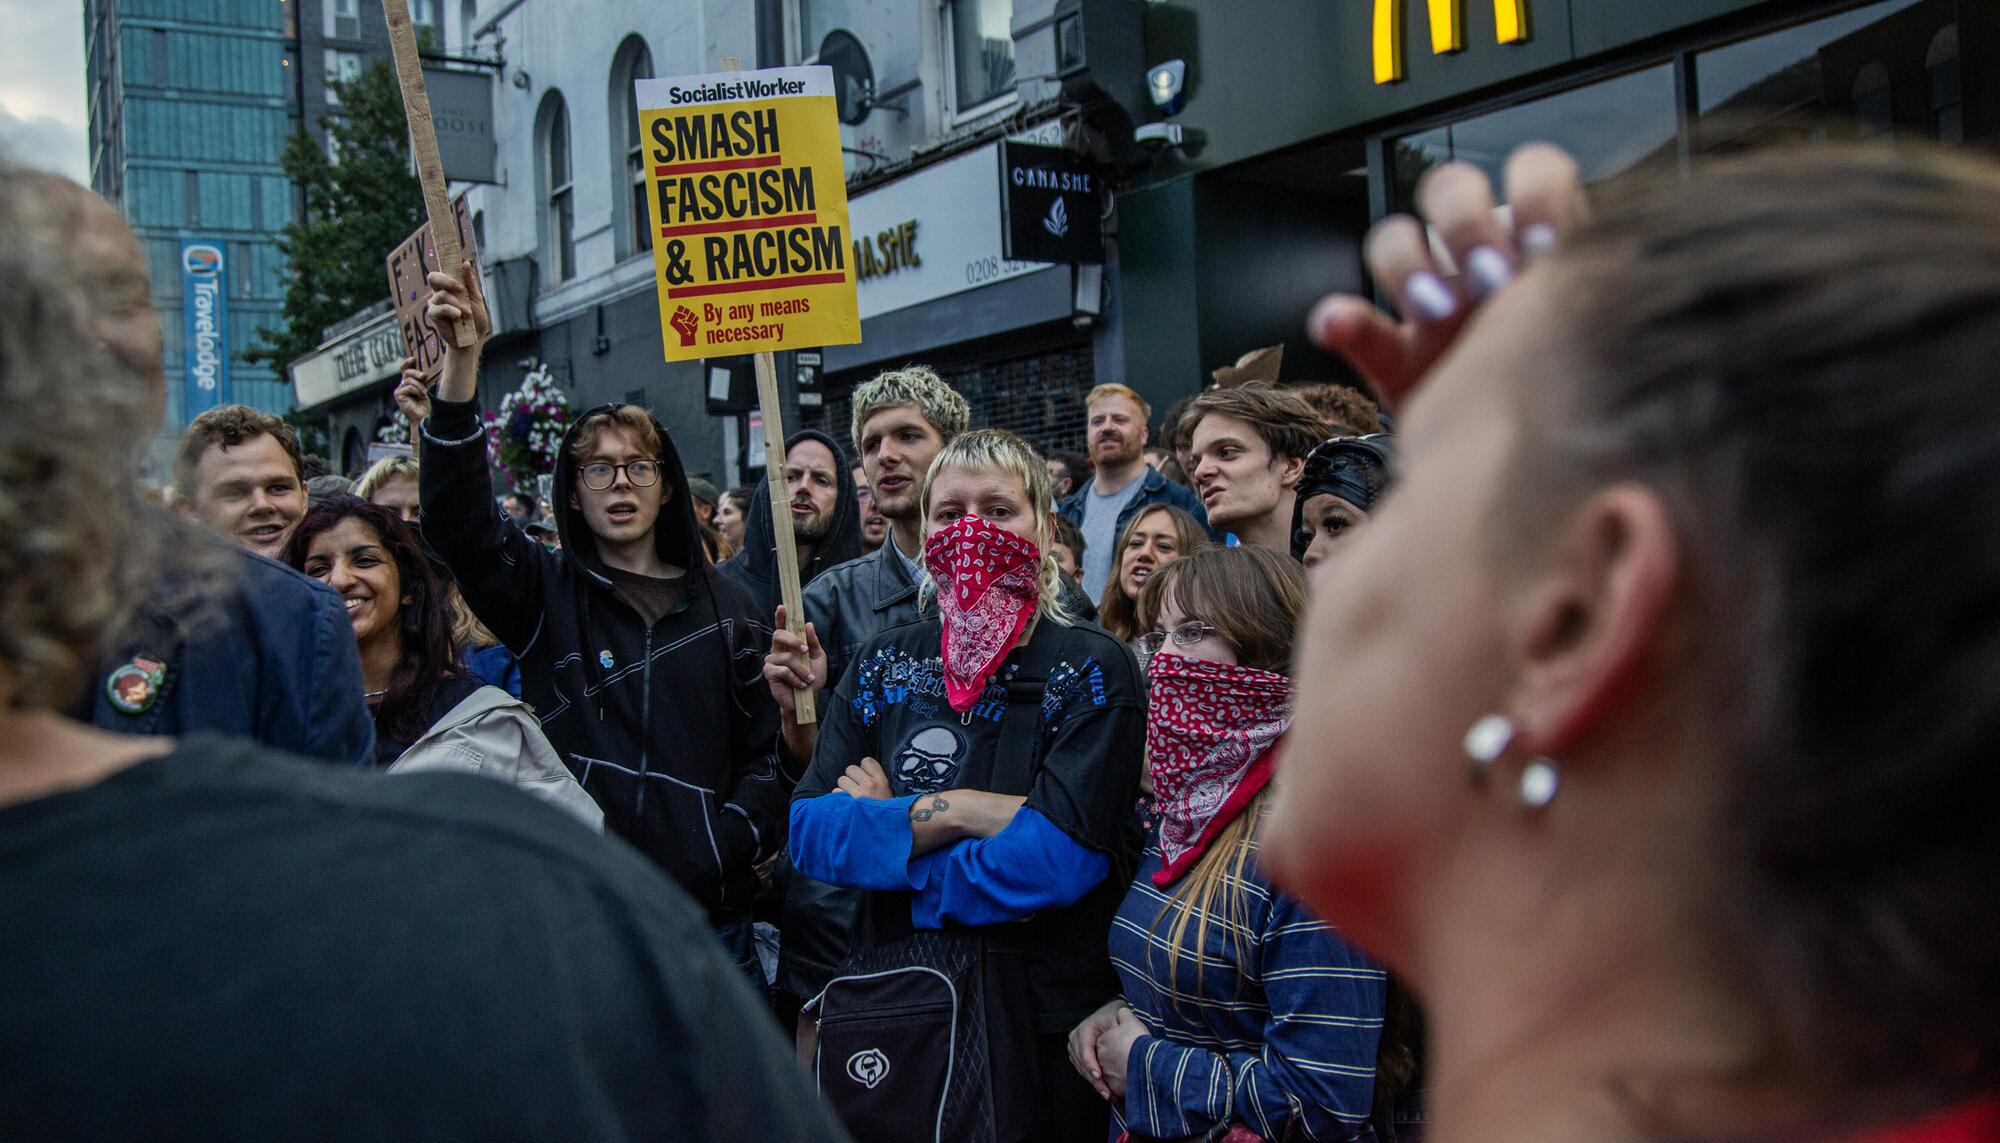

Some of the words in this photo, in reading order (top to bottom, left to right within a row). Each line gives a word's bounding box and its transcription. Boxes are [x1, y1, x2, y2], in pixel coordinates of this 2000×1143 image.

[651, 108, 780, 163] SMASH
[657, 166, 816, 224] FASCISM
[1012, 166, 1091, 193] GANASHE
[665, 239, 694, 285] &
[704, 226, 844, 281] RACISM
[967, 255, 999, 285] 0208
[193, 275, 219, 391] Travelodge
[703, 303, 723, 326] By
[728, 304, 755, 323] any
[760, 298, 811, 317] means
[706, 323, 785, 345] necessary
